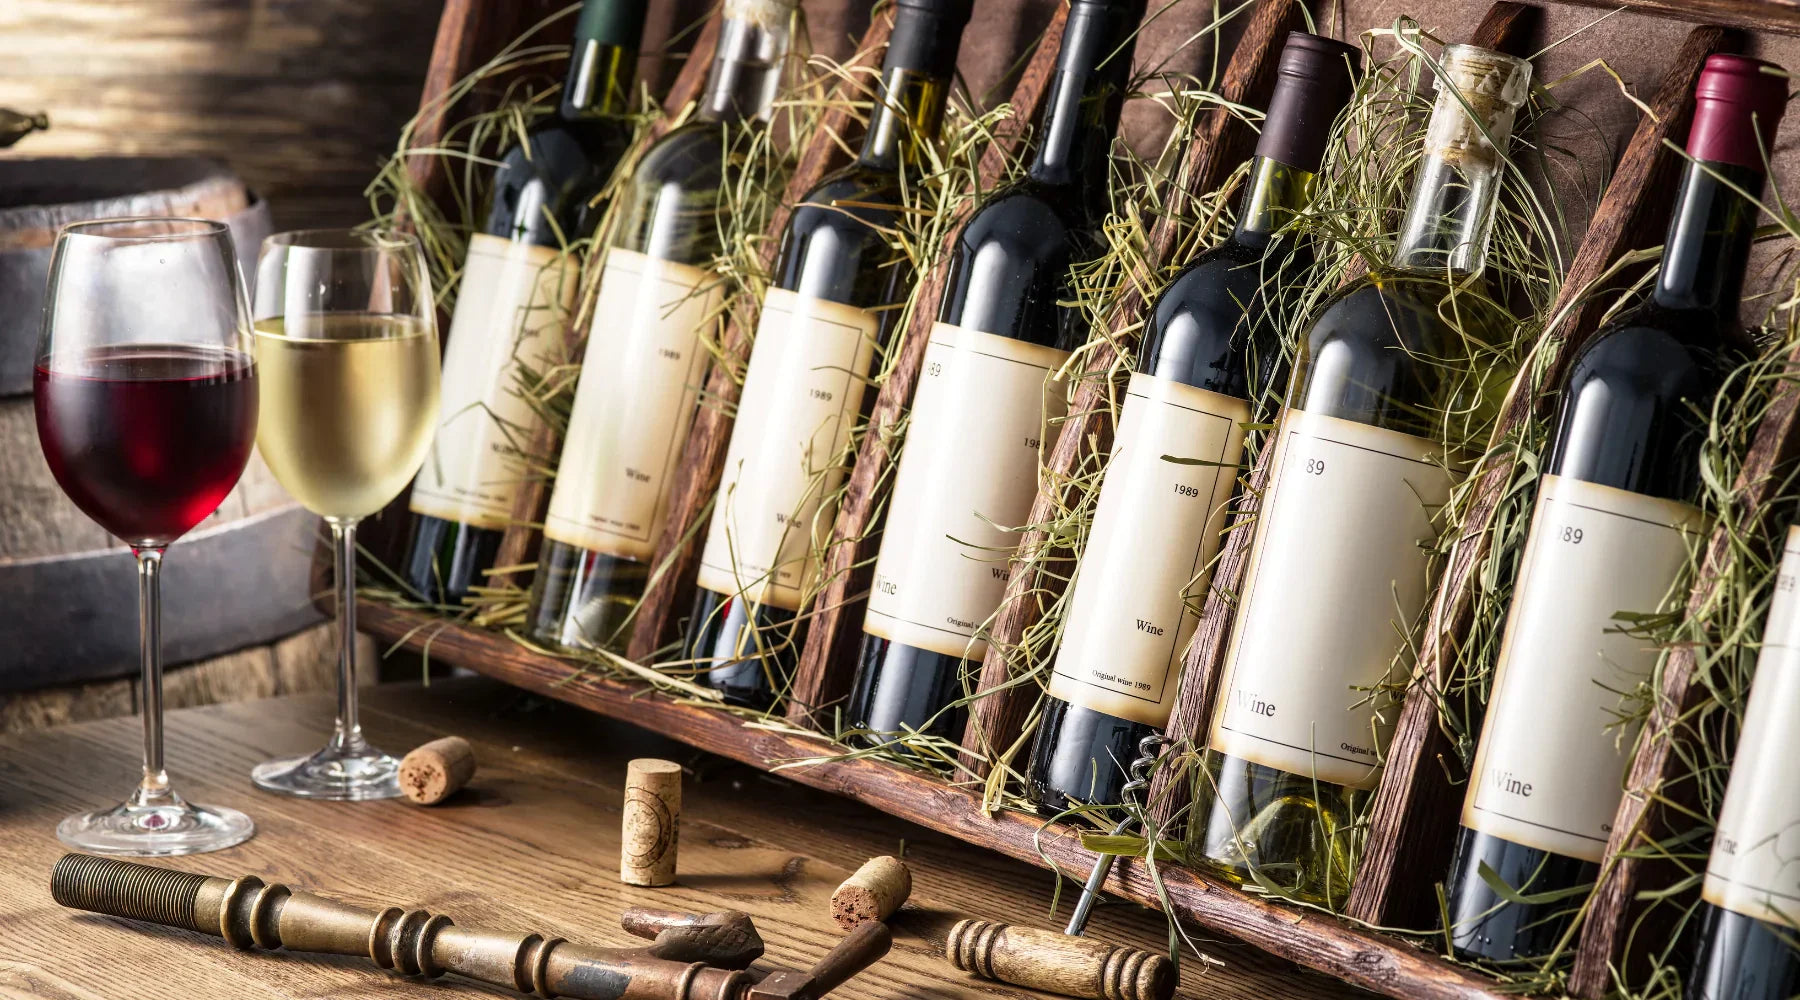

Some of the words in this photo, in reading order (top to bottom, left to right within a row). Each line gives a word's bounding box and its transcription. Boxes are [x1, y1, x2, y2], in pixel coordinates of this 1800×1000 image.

[810, 388, 833, 402] 1989
[1174, 483, 1199, 498] 1989
[946, 616, 974, 629] Original
[1136, 618, 1165, 637] Wine
[1092, 669, 1117, 682] Original
[1117, 677, 1133, 687] wine
[1134, 681, 1152, 692] 1989
[1340, 742, 1369, 756] Original
[1491, 768, 1533, 798] Wine
